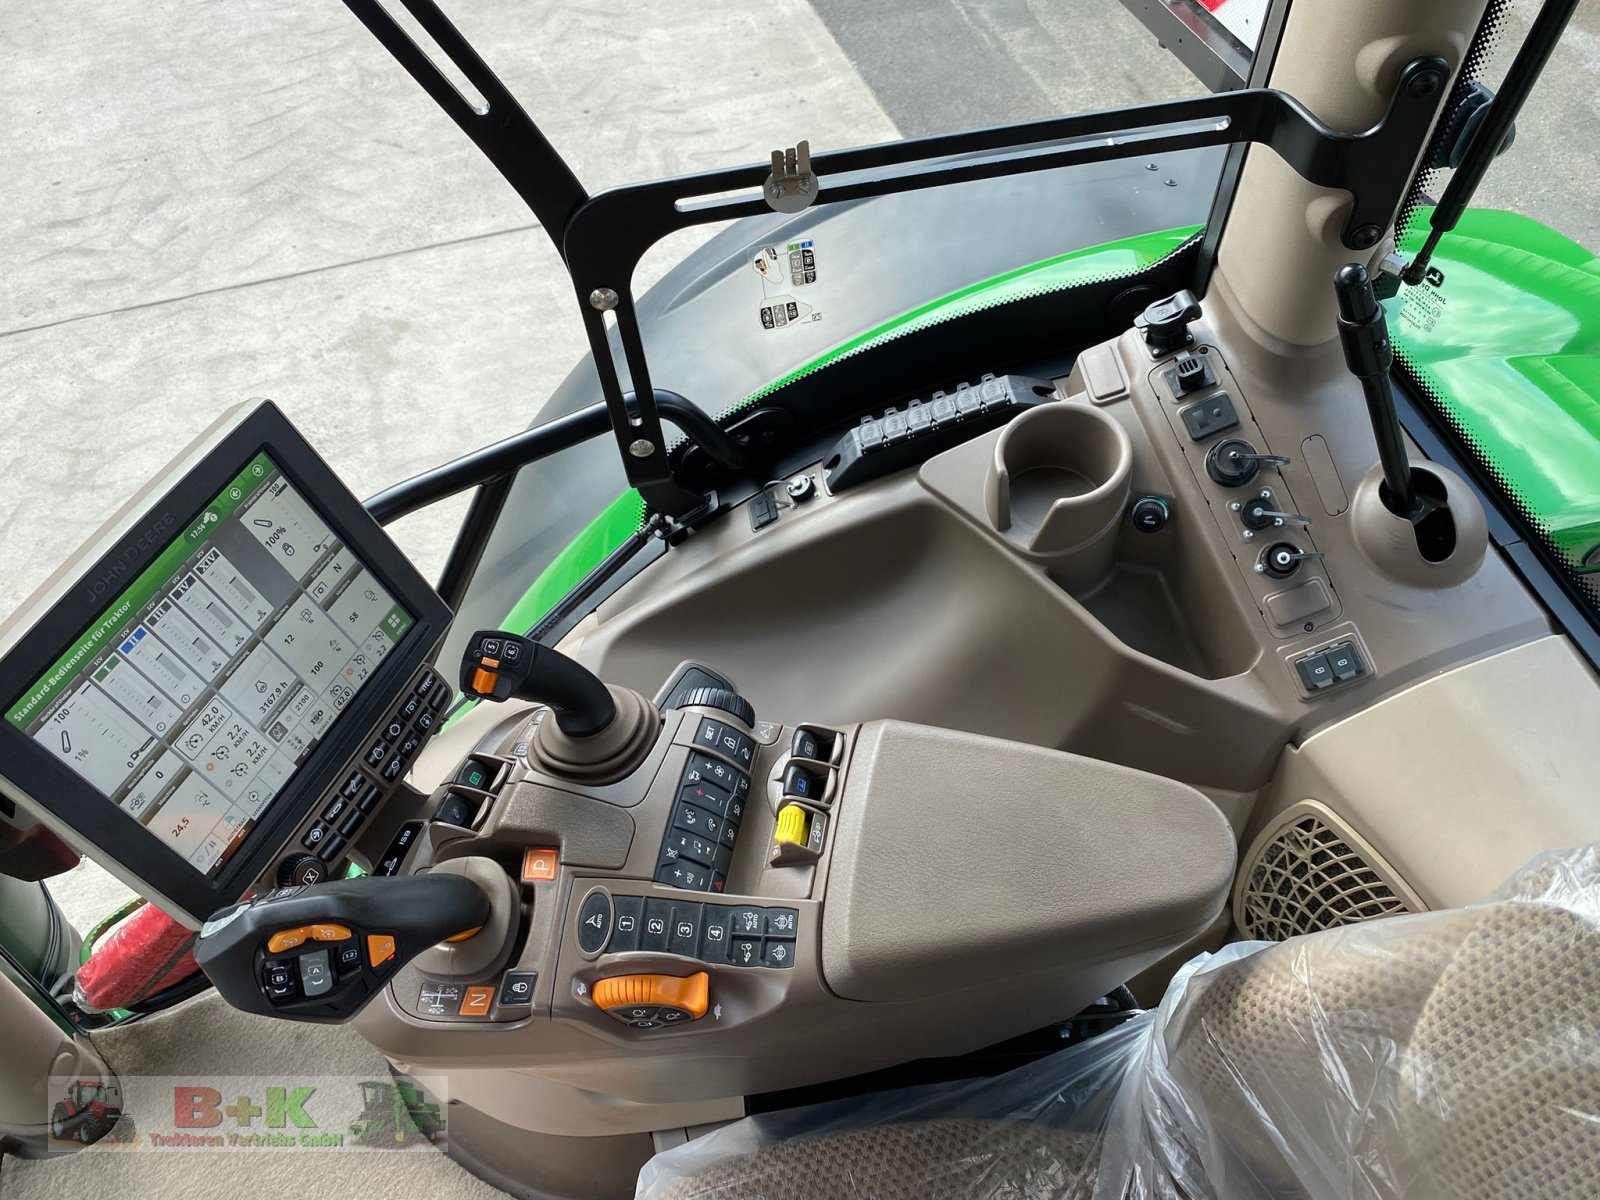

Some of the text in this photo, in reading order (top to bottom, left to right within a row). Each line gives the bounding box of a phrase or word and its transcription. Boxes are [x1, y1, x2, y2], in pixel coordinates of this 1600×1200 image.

[189, 522, 206, 539] 17:56
[264, 524, 286, 548] 100%
[87, 511, 175, 604] JOHN DEERE
[198, 552, 217, 572] XIV
[332, 562, 342, 573] N
[177, 580, 191, 594] IV
[348, 611, 359, 623] 58
[283, 633, 295, 646] 12
[376, 643, 387, 657] 2,2
[12, 599, 132, 722] Standard-Bedienseite für Traktor
[310, 660, 324, 676] 100
[357, 667, 369, 680] 2,2
[258, 686, 283, 714] 3167,9
[294, 693, 310, 711] 2100
[335, 689, 350, 707] 42,0
[52, 707, 70, 725] 100
[199, 705, 220, 727] 42,0
[208, 713, 226, 733] KM/H
[309, 708, 324, 725] ISO
[226, 723, 243, 741] 2,2
[232, 729, 250, 748] KM/H
[704, 726, 716, 740] SET
[73, 747, 89, 763] 1%
[245, 740, 261, 758] 2,2
[251, 746, 268, 764] KM/H
[171, 816, 191, 837] 24,5
[225, 816, 247, 842] AUTOTRAC
